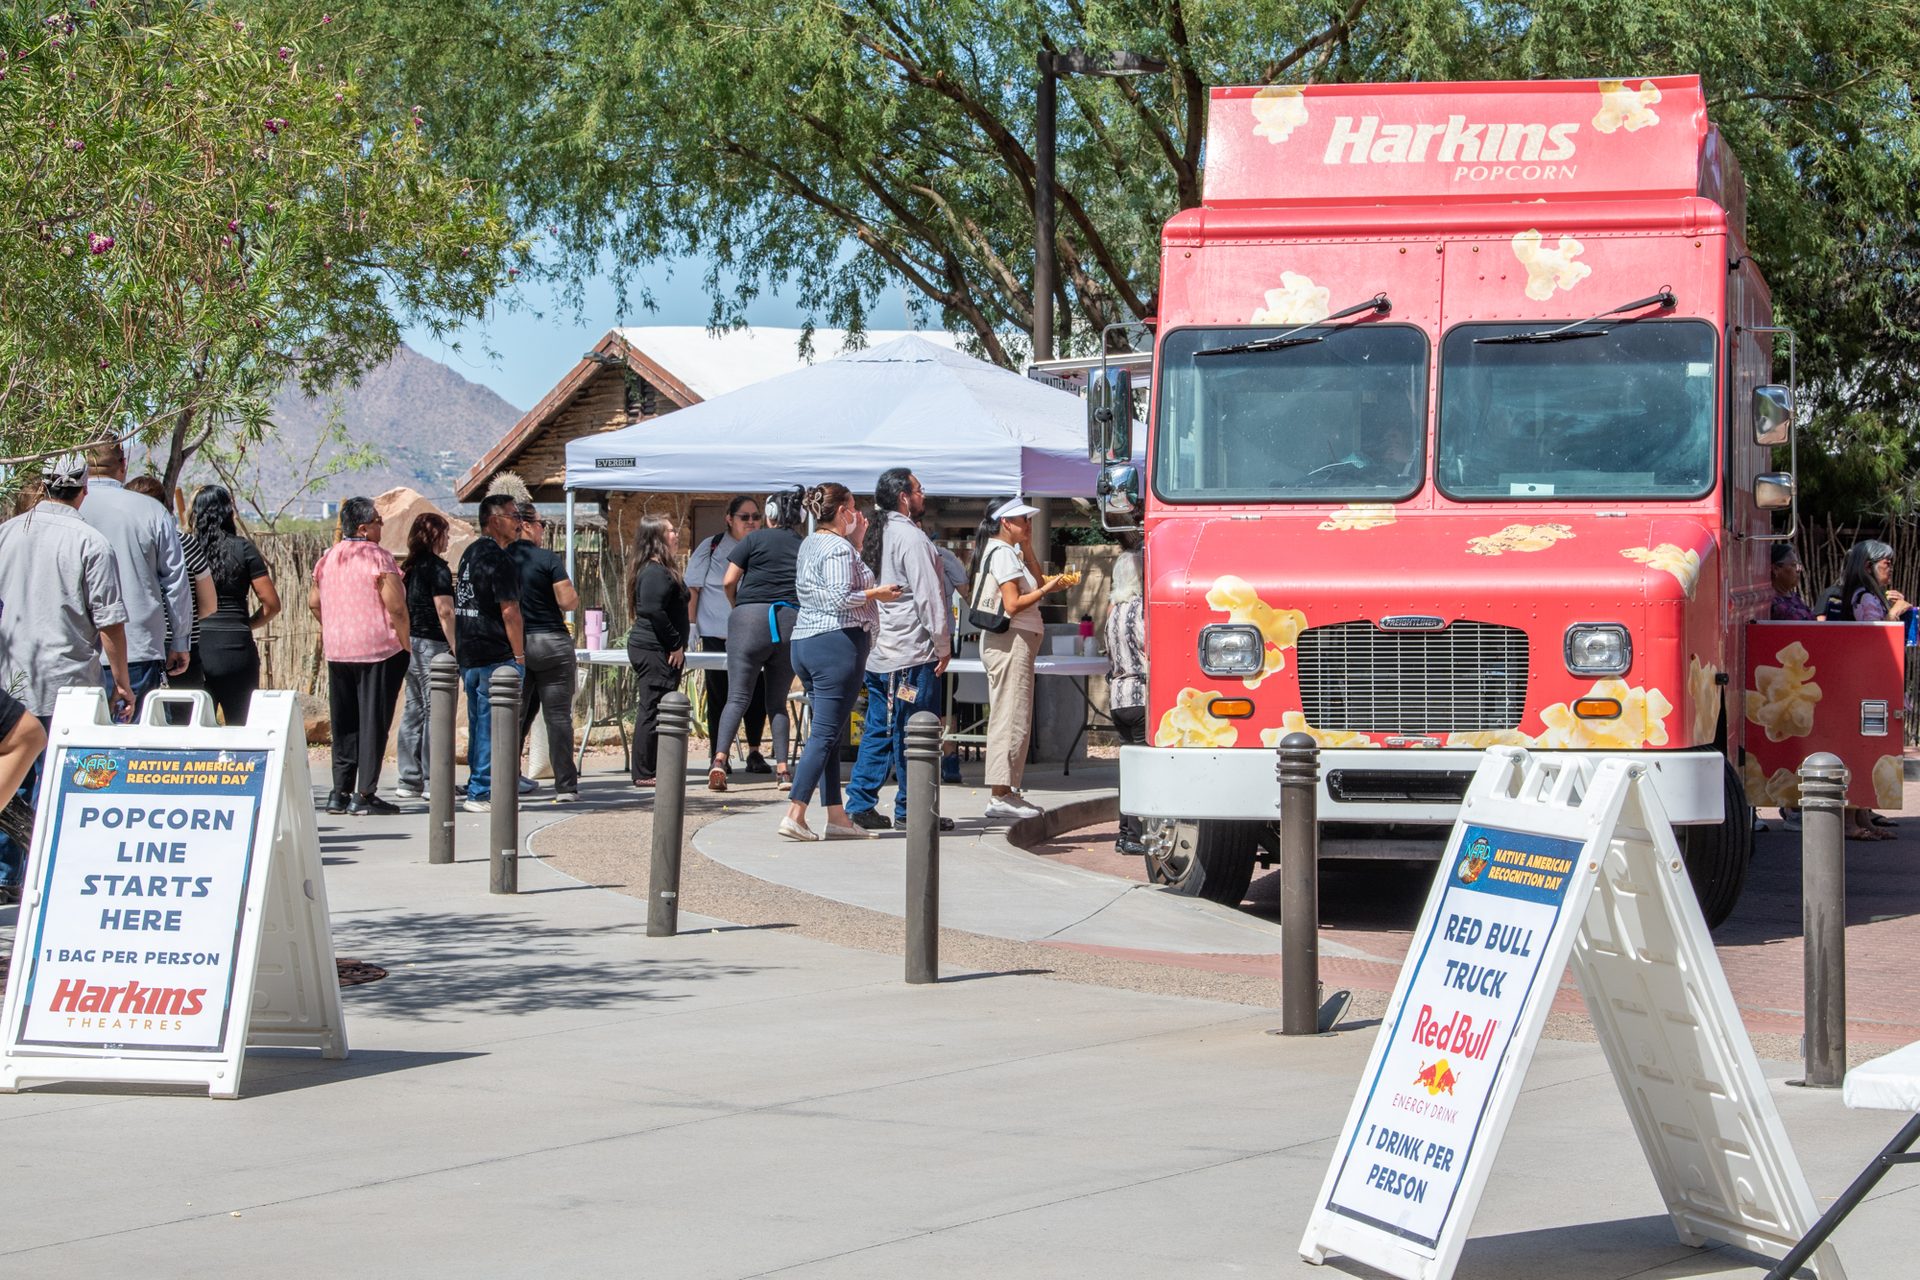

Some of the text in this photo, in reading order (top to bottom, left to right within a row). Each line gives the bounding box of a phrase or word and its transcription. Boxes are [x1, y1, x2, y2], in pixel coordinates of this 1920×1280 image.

[1324, 114, 1580, 165] Harkins
[1453, 164, 1578, 183] POPCORN
[597, 459, 634, 467] EVERBILT
[1385, 618, 1437, 626] FREIGHTLINER
[76, 758, 117, 772] NARD
[128, 760, 255, 772] NATIVE AMERICAN
[126, 773, 249, 785] RECOGNITION DAY
[79, 807, 235, 831] POPCORN
[116, 841, 187, 864] LINE
[1494, 848, 1572, 874] NATIVE AMERICAN
[79, 874, 213, 898] STARTS
[1488, 865, 1563, 891] RECOGNITION DAY
[99, 908, 183, 932] HERE
[1443, 913, 1534, 958] RED BULL
[45, 949, 220, 966] 1 BAG PER PERSON
[1443, 959, 1508, 999] TRUCK
[49, 978, 208, 1016] Harkins
[66, 1017, 182, 1031] THEATRES
[1391, 1092, 1459, 1124] ENERGY DRINK
[1365, 1124, 1455, 1173] 1 DRINK PER
[1366, 1163, 1429, 1204] PERSON
